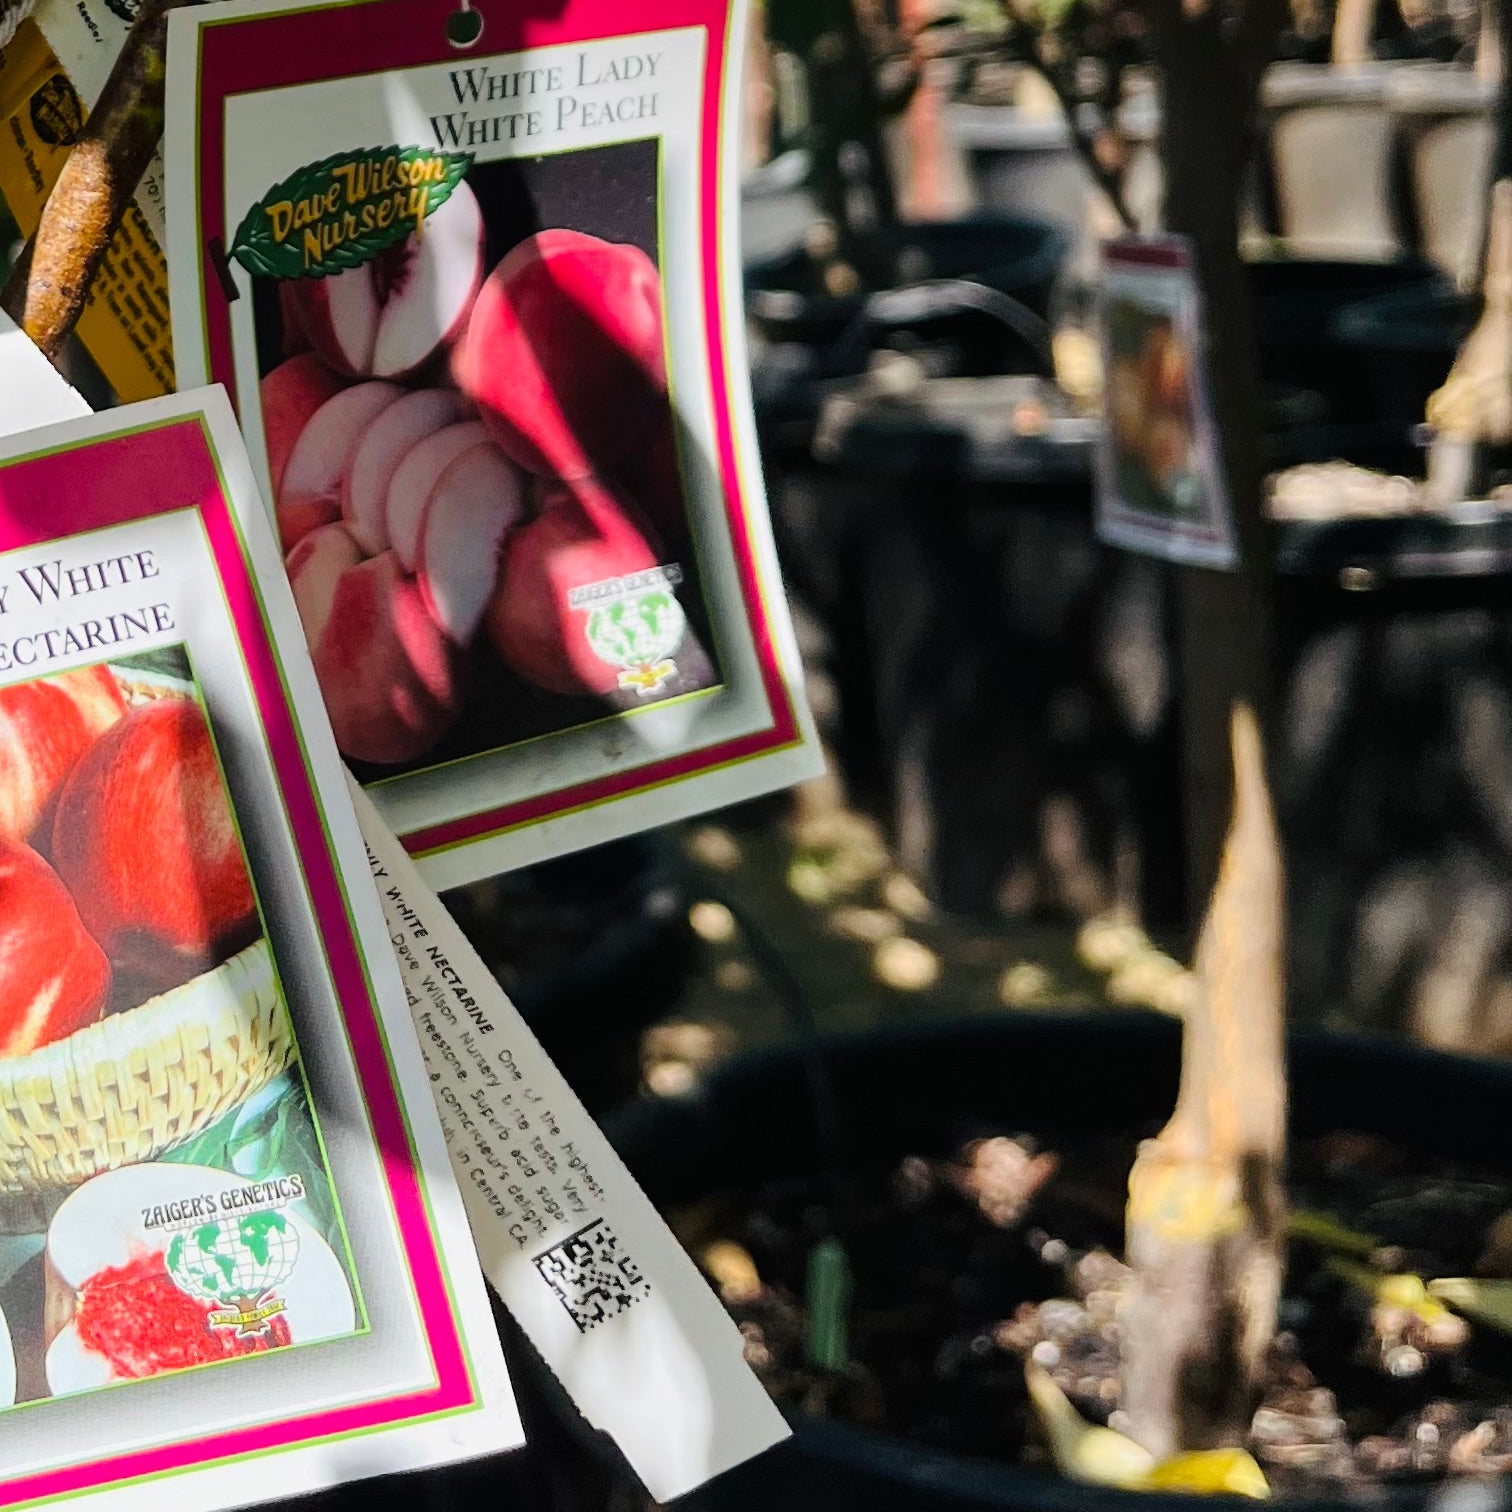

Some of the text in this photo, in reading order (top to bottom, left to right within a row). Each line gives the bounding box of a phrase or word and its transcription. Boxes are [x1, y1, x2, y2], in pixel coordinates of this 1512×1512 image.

[448, 51, 664, 106] WHITE LADY
[428, 92, 659, 150] WHITE PEACH
[266, 154, 445, 243] Dave Wilson
[301, 185, 430, 269] Nursery
[16, 549, 161, 606] WHITE
[387, 886, 427, 939] WHITE
[426, 944, 492, 1036] NECTARINE
[498, 1049, 523, 1081] One
[540, 1110, 562, 1136] the
[391, 934, 420, 970] Dave
[421, 976, 458, 1025] Wilson
[459, 1032, 501, 1089] Nursery
[559, 1179, 587, 1215] Very
[142, 1194, 218, 1229] ZAIGER'S
[220, 1175, 303, 1211] GENETICS
[469, 1166, 508, 1220] Central
